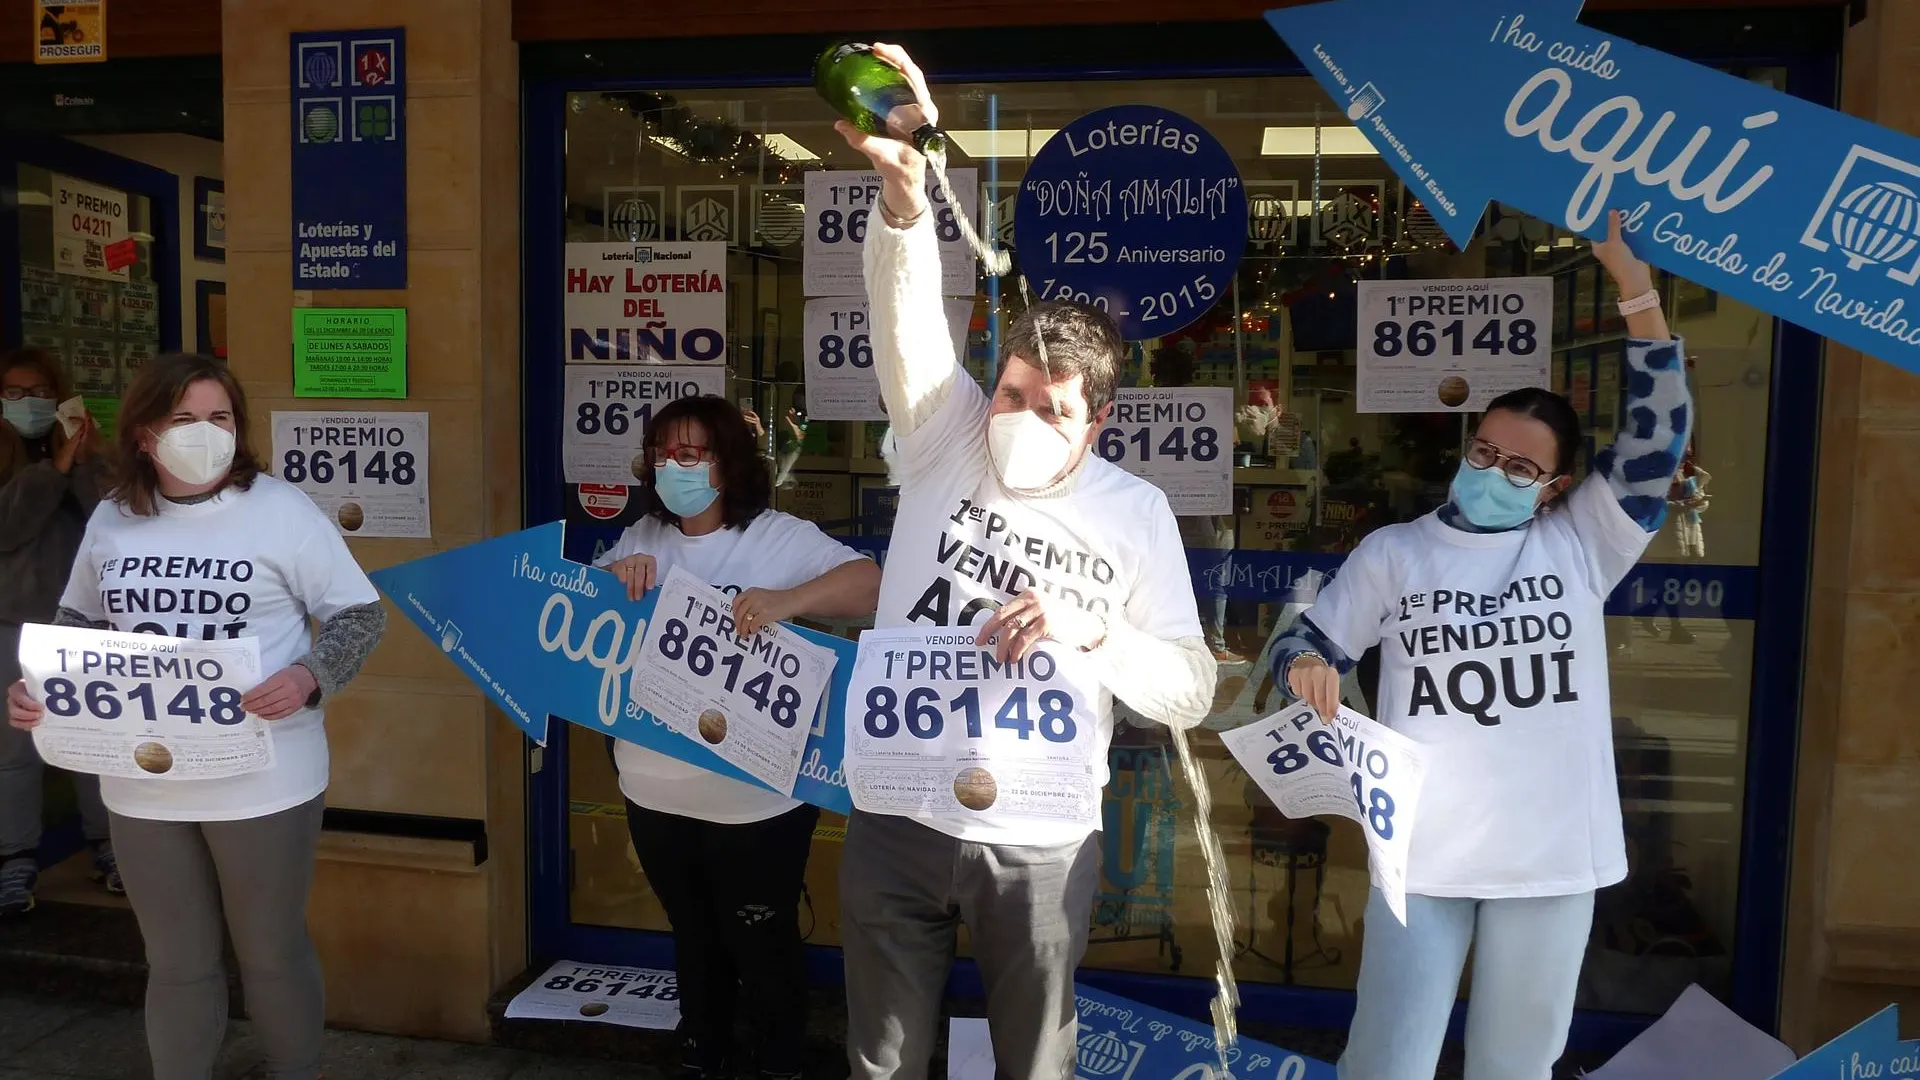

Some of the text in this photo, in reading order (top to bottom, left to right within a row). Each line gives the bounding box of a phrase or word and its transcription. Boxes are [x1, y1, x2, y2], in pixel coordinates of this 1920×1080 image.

[40, 46, 101, 57] PROSEGUR
[1312, 43, 1354, 96] Loterías y
[1064, 119, 1200, 157] Loterías
[1504, 67, 1779, 233] aquí
[1371, 115, 1458, 218] Apuestas del Estado
[77, 193, 121, 217] PREMIO
[72, 214, 111, 238] 04211
[299, 221, 373, 239] Loterías y
[300, 240, 397, 261] Apuestas del
[602, 251, 691, 260] Lotería Nacional
[1045, 232, 1226, 263] 125 Aniversario
[1616, 201, 1650, 234] el
[1654, 212, 1749, 276] Gordo
[1752, 251, 1794, 292] de
[300, 262, 350, 279] Estado
[568, 268, 723, 293] HAY LOTERÍA
[1139, 275, 1215, 322] 2015
[1422, 284, 1489, 293] VENDIDO AQUÍ
[624, 299, 664, 317] DEL
[1387, 294, 1524, 317] 1er PREMIO
[327, 317, 370, 325] HORARIO
[309, 342, 318, 350] DE
[321, 342, 343, 350] LUNES
[345, 342, 352, 350] A
[571, 320, 724, 361] NIÑO
[1373, 319, 1537, 357] 86148
[653, 370, 672, 378] AQUÍ
[588, 380, 700, 400] 1er PREMIO
[357, 416, 376, 424] AQUÍ
[310, 427, 405, 447] PREMIO
[1098, 426, 1219, 463] 6148
[283, 450, 416, 486] 86148
[950, 498, 986, 526] 1er
[120, 556, 253, 582] PREMIO
[1399, 574, 1564, 621] 1er PREMIO
[1631, 576, 1724, 607] 1.890
[408, 592, 437, 626] Loterías
[685, 596, 703, 619] 1er
[100, 639, 179, 654] VENDIDO AQUÍ
[925, 635, 975, 645] VENDIDO
[1400, 611, 1572, 658] VENDIDO
[56, 648, 223, 682] 1er PREMIO
[658, 618, 801, 729] 86148
[884, 650, 1056, 682] 1er PREMIO
[458, 646, 530, 724] Apuestas del Estado
[1408, 643, 1579, 727] AQUÍ
[44, 677, 246, 726] 86148
[864, 685, 1078, 743] 86148
[1265, 722, 1288, 744] 1er
[544, 975, 680, 1001] 86148
